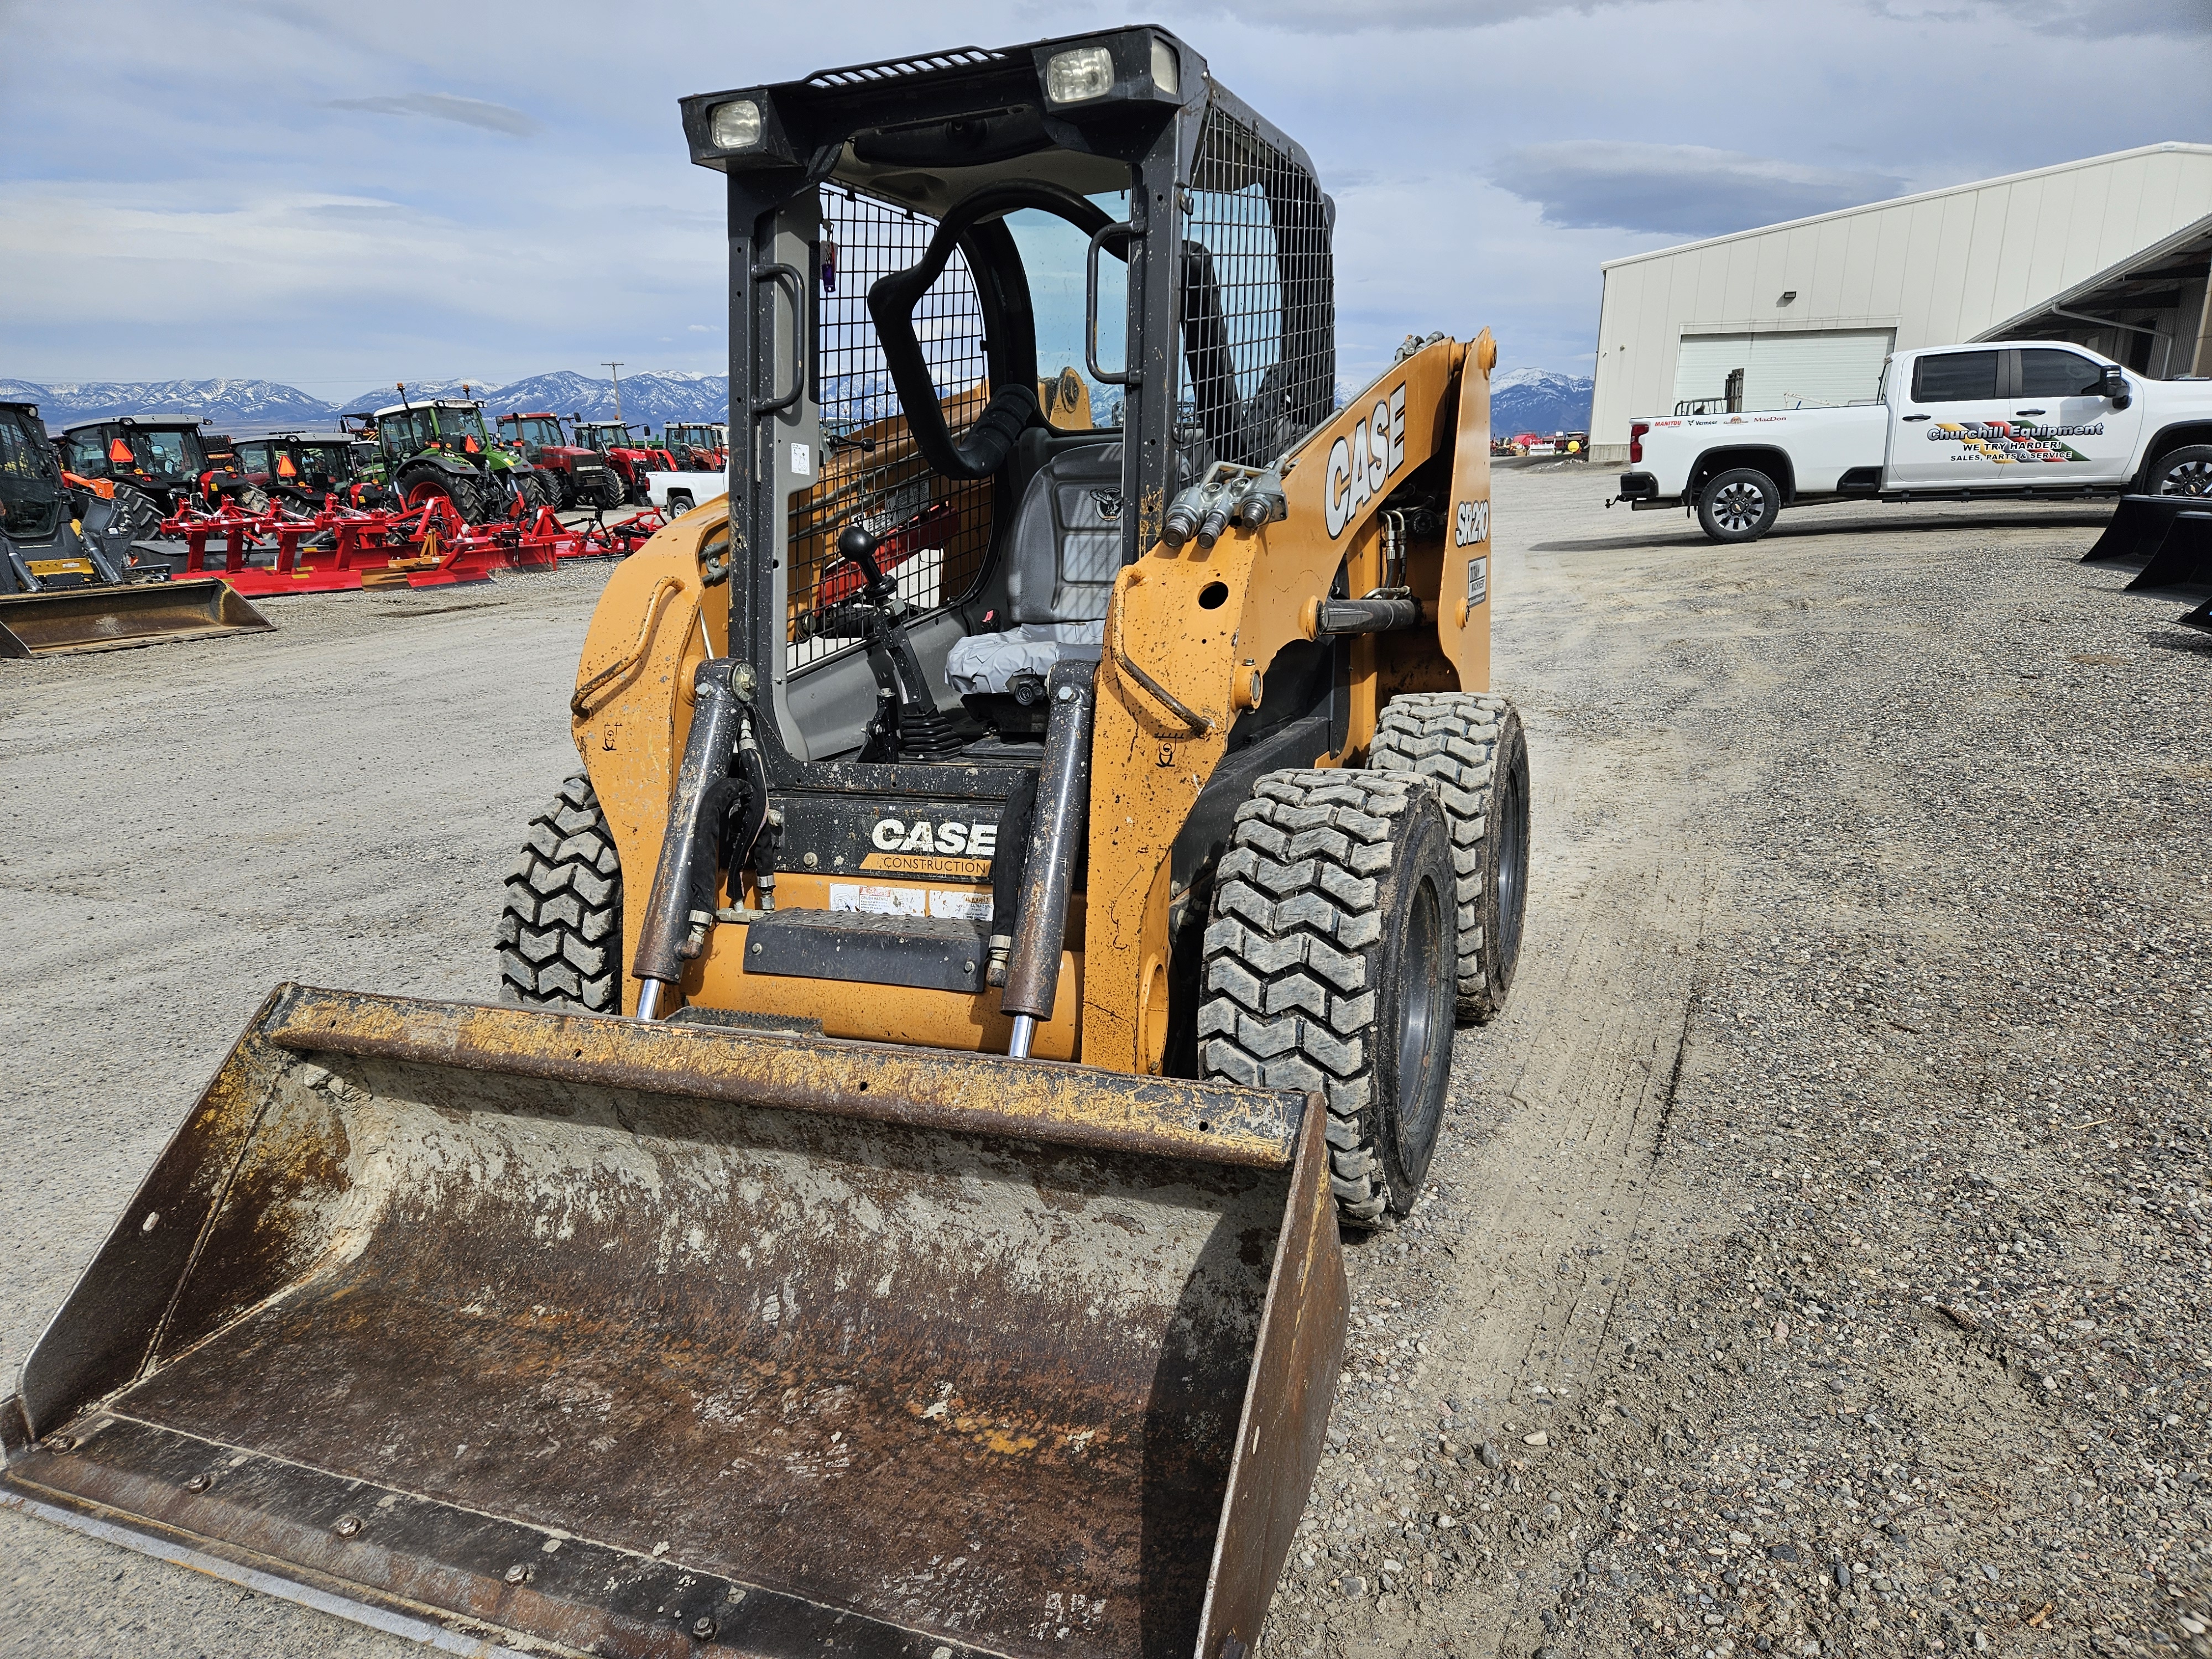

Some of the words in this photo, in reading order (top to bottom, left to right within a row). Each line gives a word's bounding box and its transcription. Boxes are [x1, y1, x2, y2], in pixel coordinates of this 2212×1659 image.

[1927, 425, 2005, 441] Churchill
[2008, 422, 2104, 440] Equipment
[2010, 441, 2062, 450] HARDER!
[1324, 380, 1406, 540] CASE
[1455, 499, 1489, 548] SR210
[872, 819, 998, 855] CASE
[884, 857, 986, 874] CONSTRUCTION
